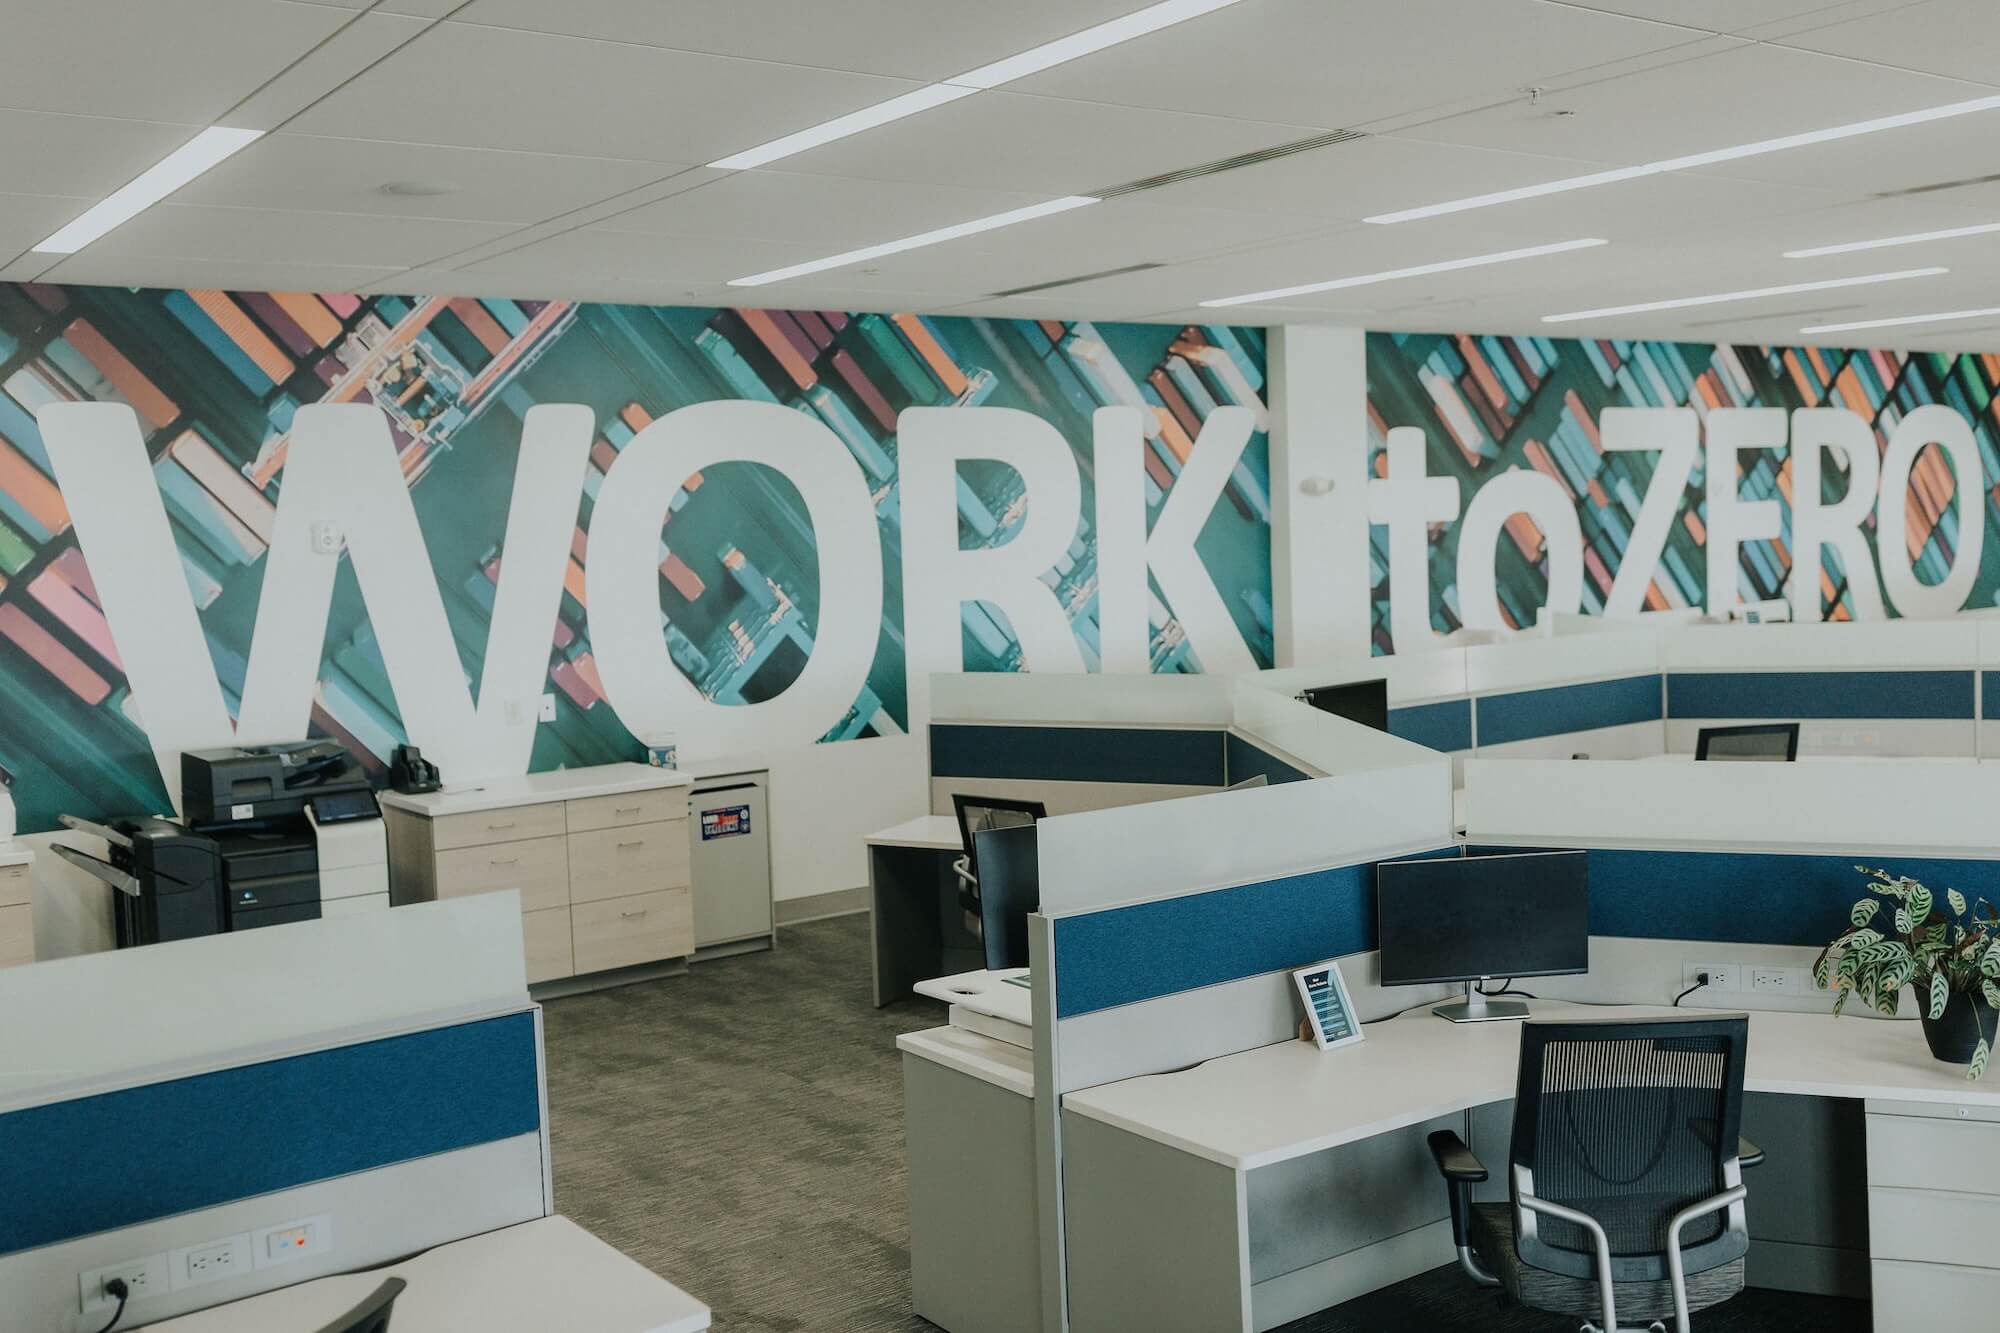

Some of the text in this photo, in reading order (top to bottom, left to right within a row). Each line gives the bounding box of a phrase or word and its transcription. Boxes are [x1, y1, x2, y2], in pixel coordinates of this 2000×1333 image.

[36, 398, 1986, 815] WORK to ZERO
